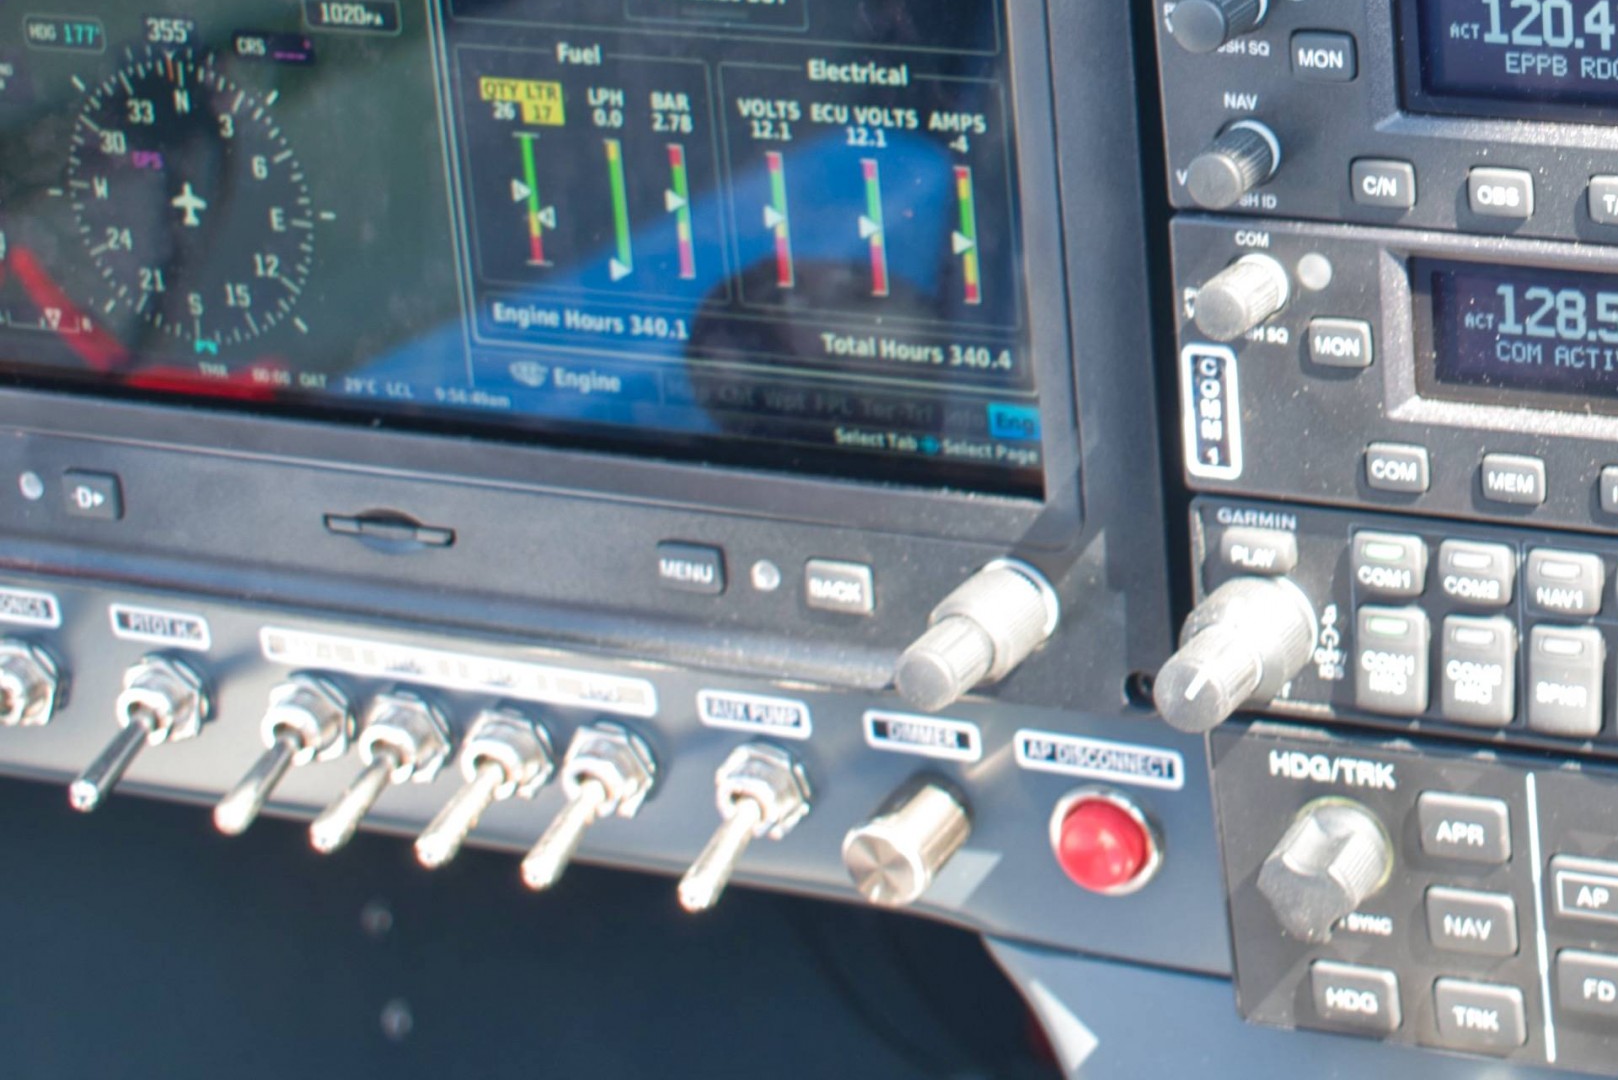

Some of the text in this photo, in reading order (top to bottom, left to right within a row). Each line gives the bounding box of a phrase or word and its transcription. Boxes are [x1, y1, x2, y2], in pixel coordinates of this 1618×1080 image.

[1450, 23, 1481, 41] ACT
[557, 43, 601, 66] Fuel
[1298, 49, 1344, 70] MON
[1505, 52, 1568, 77] EPPB
[808, 60, 908, 85] Electrical
[737, 97, 800, 120] VOLTS
[1224, 94, 1257, 111] NAV
[810, 104, 917, 128] ECU VOLTS
[929, 112, 986, 134] AMPS
[1477, 186, 1520, 207] OBS
[1235, 231, 1269, 249] COM
[493, 302, 689, 341] Engine Hours 340.1
[1465, 313, 1494, 330] ACT
[822, 333, 1012, 370] Total Hours 340.4
[1314, 336, 1360, 358] MON
[1496, 341, 1542, 364] COM
[552, 367, 621, 392] Engine
[835, 428, 917, 451] Select Tab
[943, 440, 1038, 464] Select Page
[1371, 461, 1418, 482] COM
[1488, 471, 1534, 494] MEM
[1217, 508, 1296, 529] GARMIN
[658, 559, 714, 584] MENU
[809, 576, 862, 603] BACK
[1536, 585, 1584, 609] NAV1
[886, 721, 959, 748] DIMMER
[1270, 750, 1396, 789] HDG/TRK
[1436, 823, 1484, 846] APR
[1577, 887, 1609, 907] AP
[1444, 916, 1491, 940] NAV
[1585, 978, 1616, 1001] FD
[1326, 988, 1378, 1015] HDG
[1454, 1006, 1499, 1031] TRK
